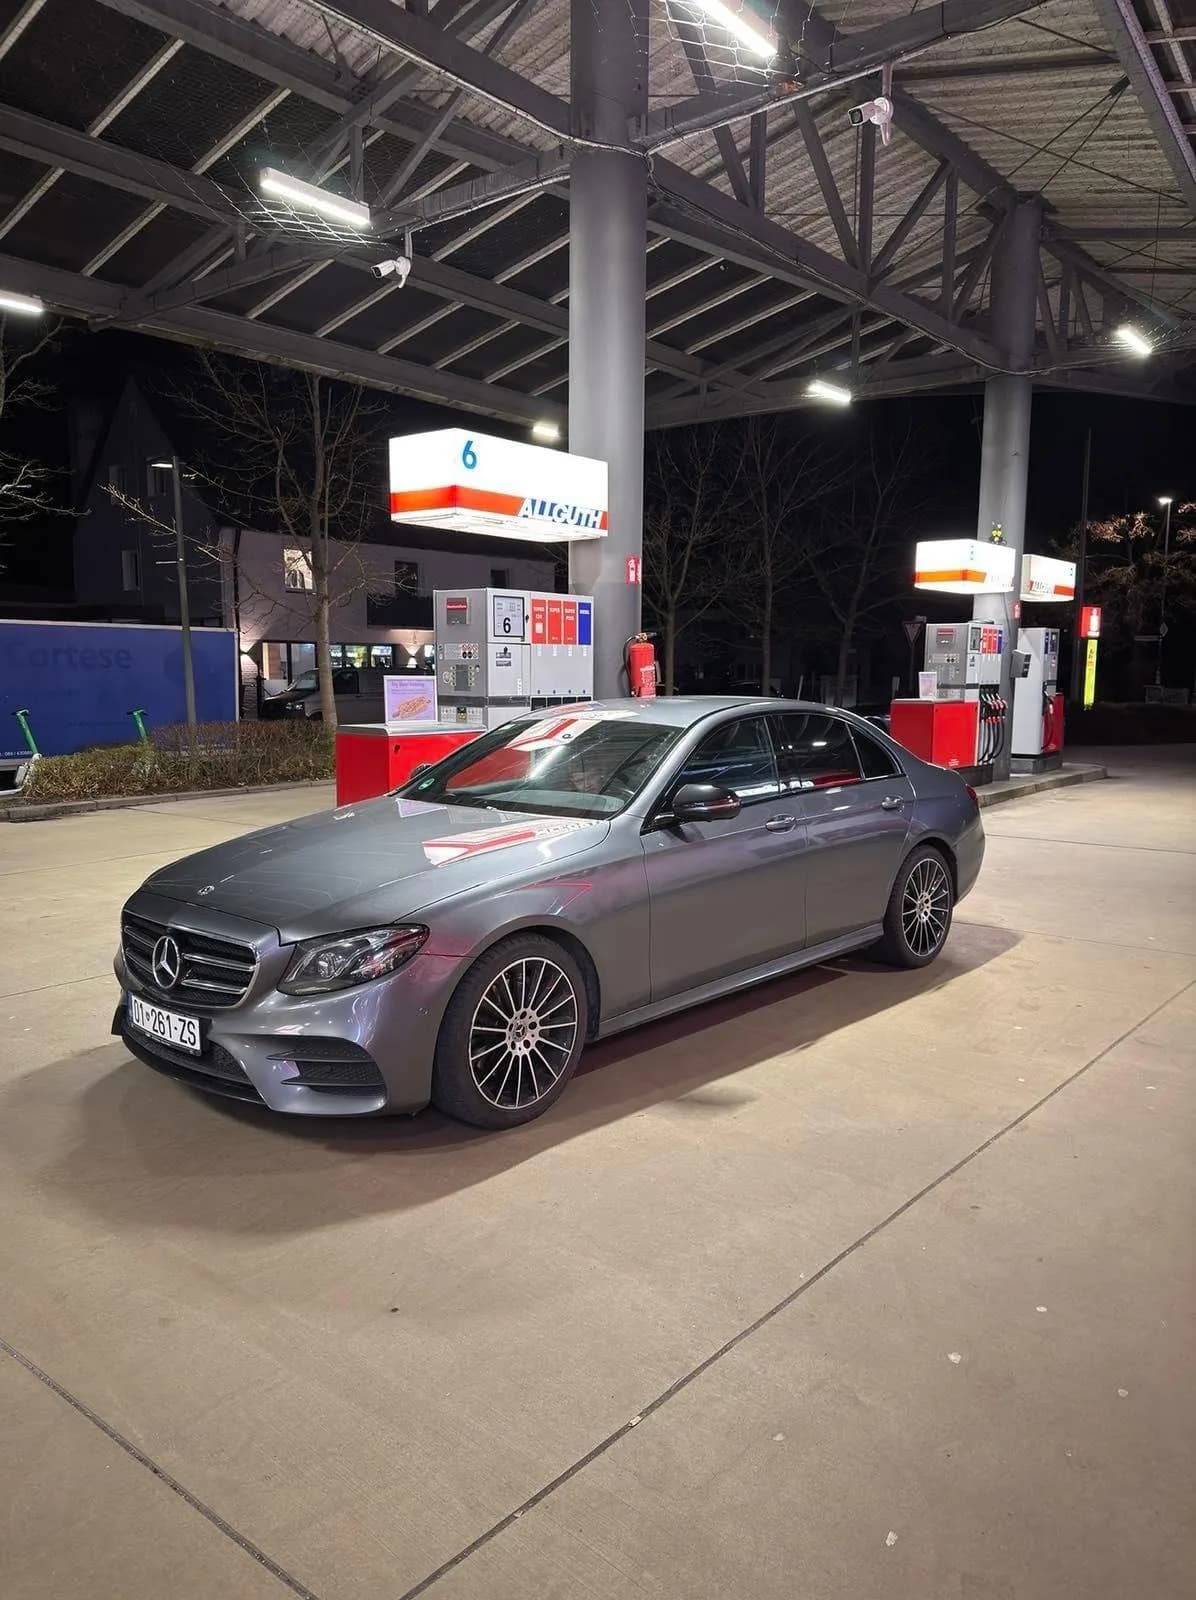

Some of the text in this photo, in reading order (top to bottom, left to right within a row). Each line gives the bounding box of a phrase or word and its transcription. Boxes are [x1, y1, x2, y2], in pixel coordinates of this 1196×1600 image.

[461, 440, 478, 470] 6
[518, 498, 603, 529] ALLGUTH
[503, 617, 511, 633] 6
